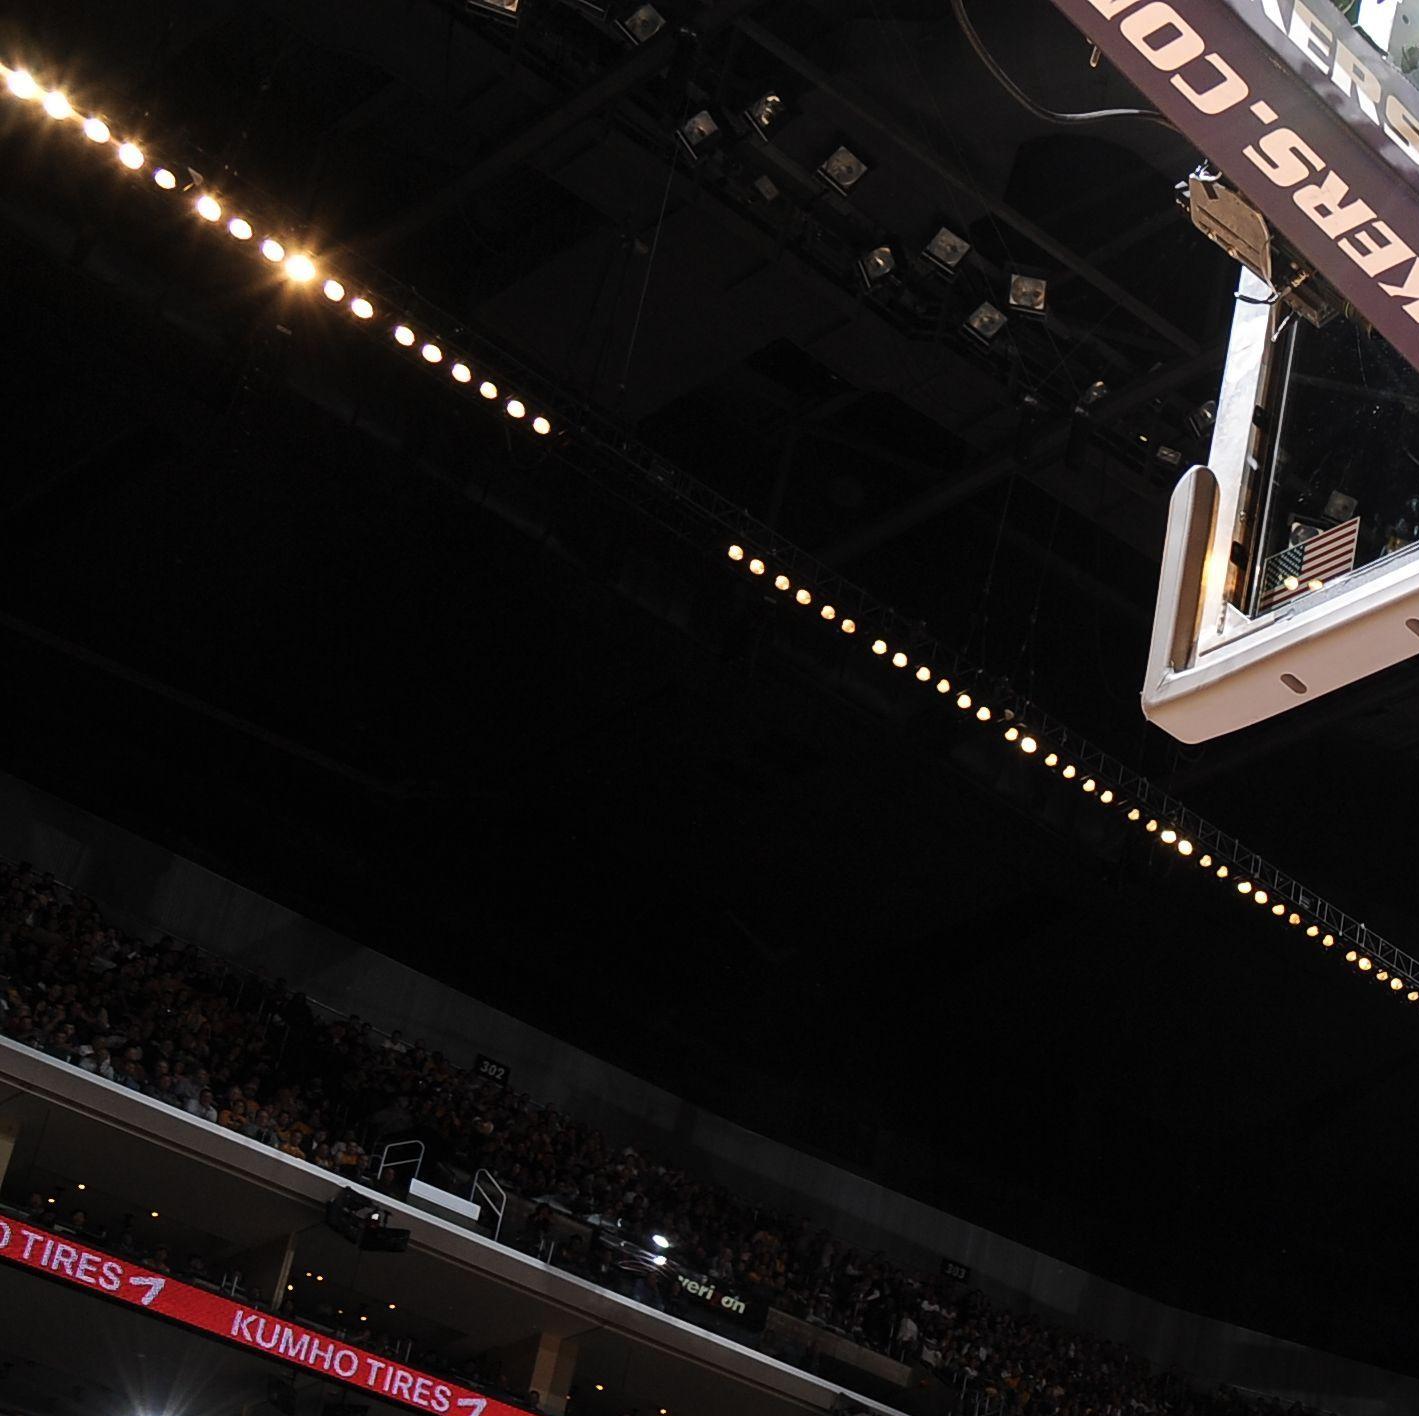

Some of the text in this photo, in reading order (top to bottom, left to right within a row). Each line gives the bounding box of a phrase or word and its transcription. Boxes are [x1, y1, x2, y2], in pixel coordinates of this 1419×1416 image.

[21, 1228, 124, 1291] TIRES
[231, 1309, 452, 1413] KUMHO TIRES
